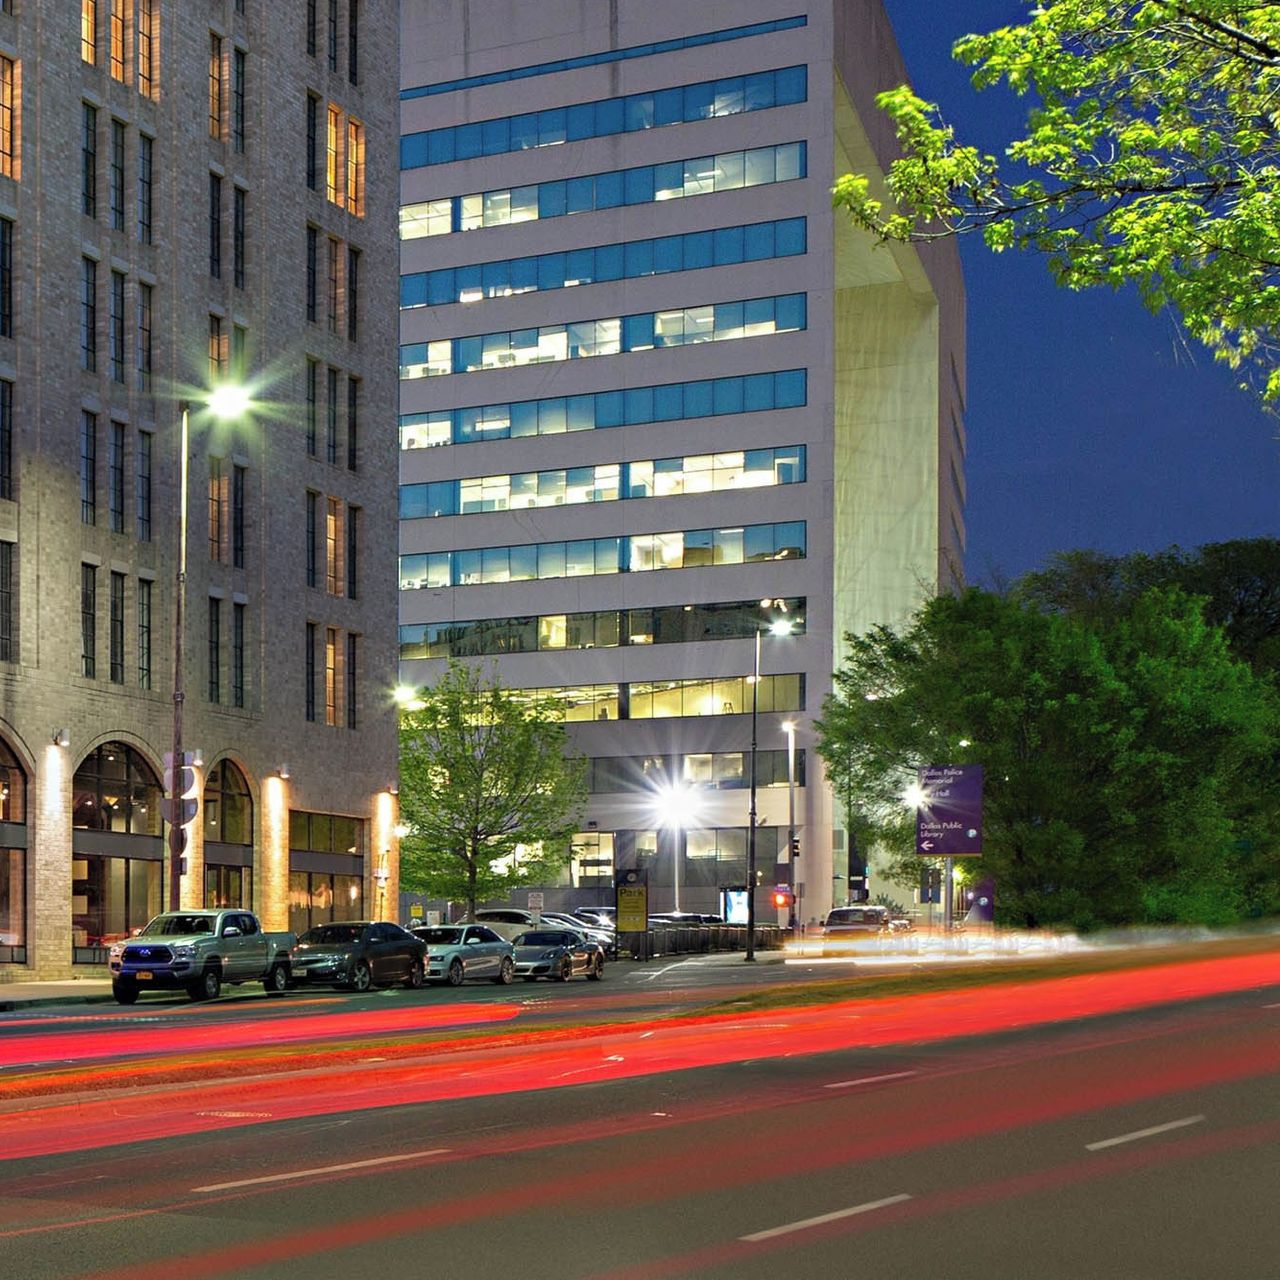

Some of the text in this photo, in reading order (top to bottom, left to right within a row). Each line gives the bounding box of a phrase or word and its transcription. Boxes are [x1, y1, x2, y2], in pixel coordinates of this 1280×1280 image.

[922, 769, 942, 777] Dallas
[942, 821, 962, 829] Public
[921, 830, 944, 839] Library
